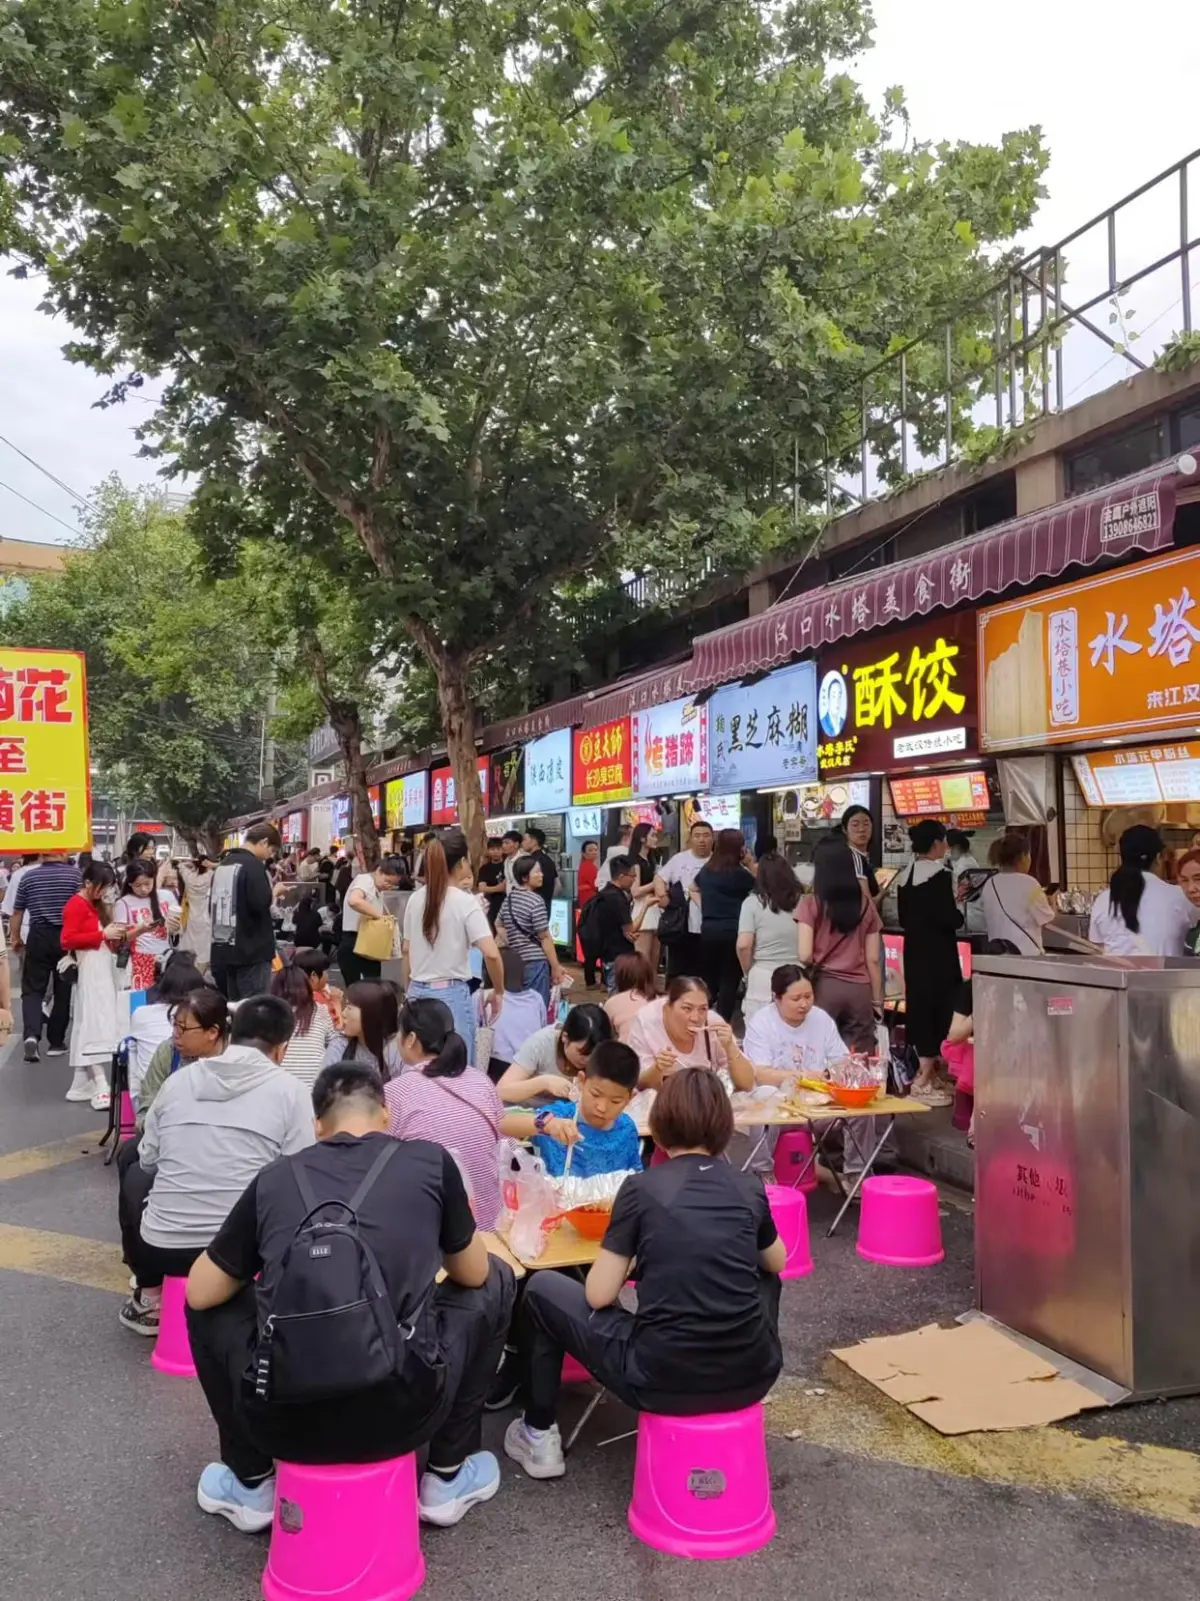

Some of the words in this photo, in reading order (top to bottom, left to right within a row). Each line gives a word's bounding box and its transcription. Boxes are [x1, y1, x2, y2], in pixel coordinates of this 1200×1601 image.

[775, 559, 971, 646] 汉口水塔美食街
[1088, 586, 1200, 676] 水塔
[853, 637, 966, 729] 酥饺
[1054, 617, 1074, 717] 水塔巷小吃
[0, 668, 72, 723] 花
[644, 723, 694, 776] 烤猪蹄
[728, 701, 808, 754] 黑芝麻糊
[586, 763, 623, 789] 长沙臭豆腐
[312, 1247, 329, 1256] ELLE
[255, 1358, 269, 1396] ELLE
